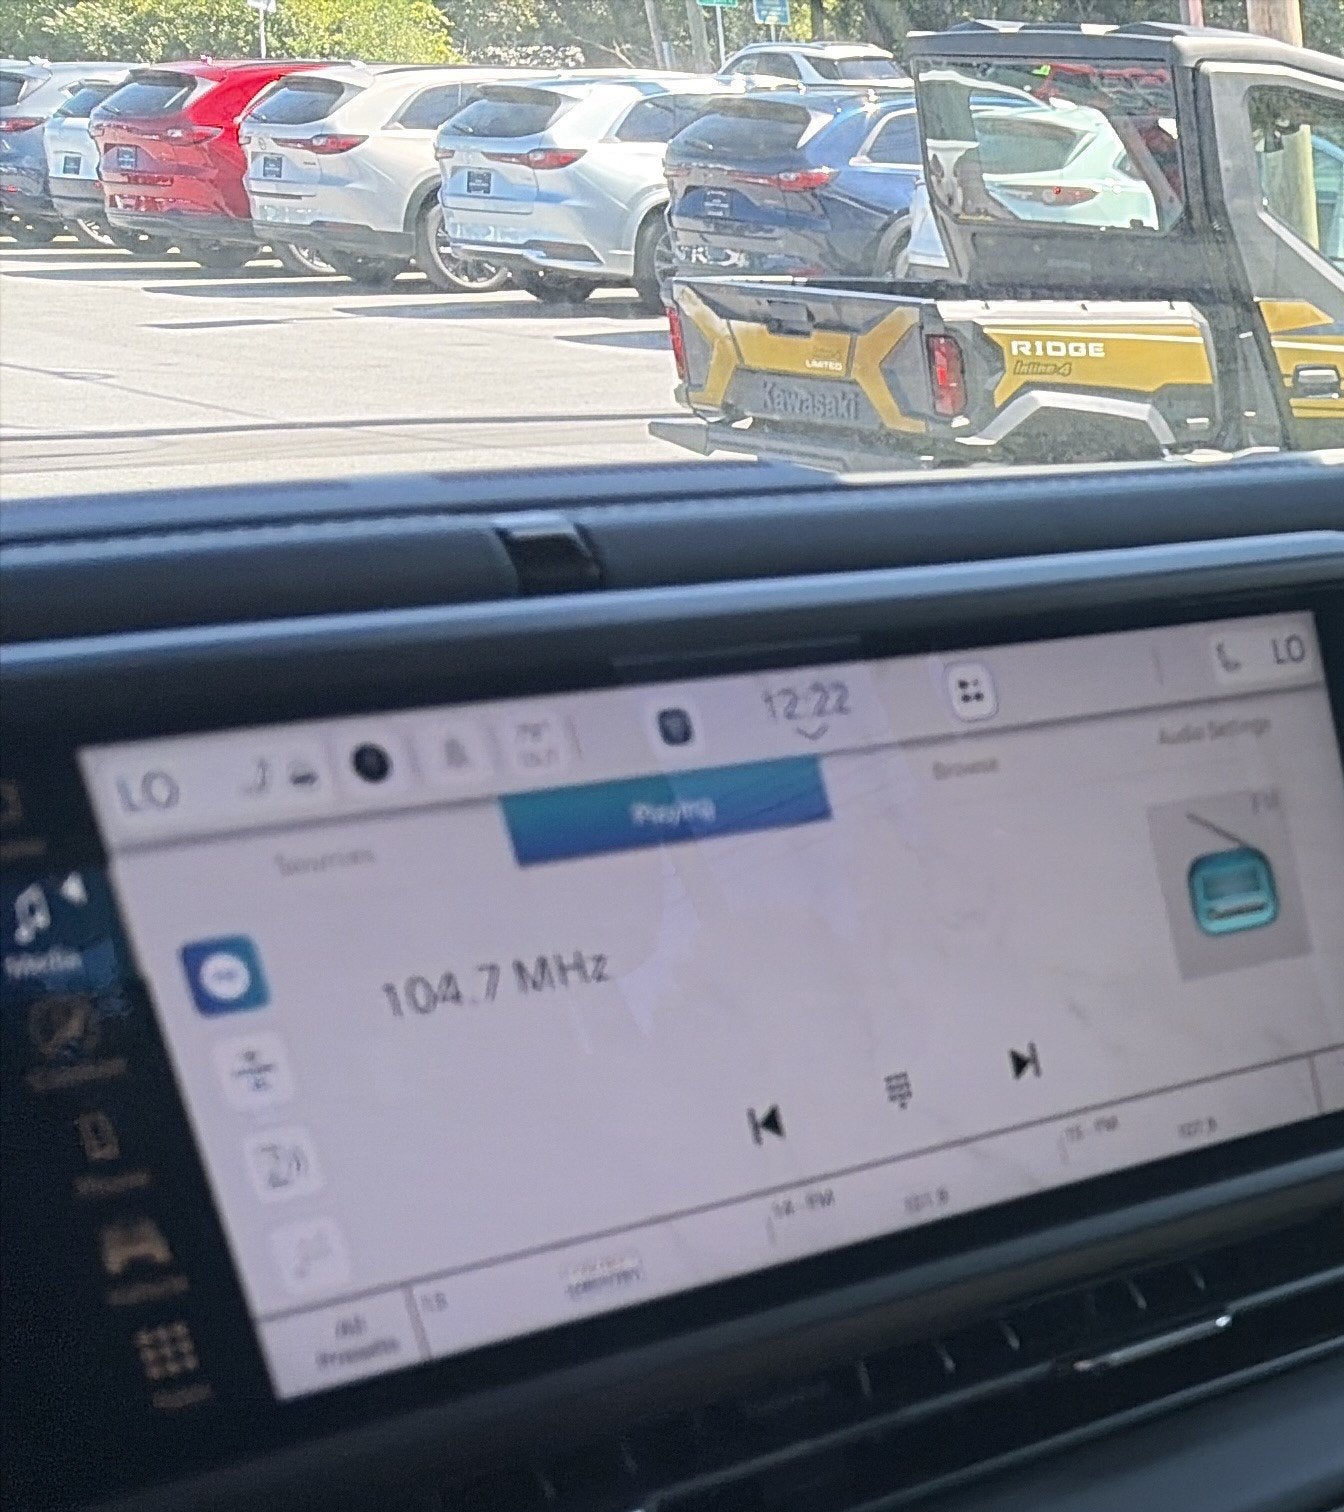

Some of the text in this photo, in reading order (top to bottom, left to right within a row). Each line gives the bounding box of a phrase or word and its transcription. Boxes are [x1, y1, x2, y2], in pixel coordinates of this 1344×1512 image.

[1010, 340, 1106, 358] RIDGE
[762, 380, 860, 419] Kawasaki
[1271, 633, 1307, 665] LO
[763, 681, 851, 721] 12:22
[116, 770, 181, 813] LO
[383, 950, 611, 1017] 104.7 MHz
